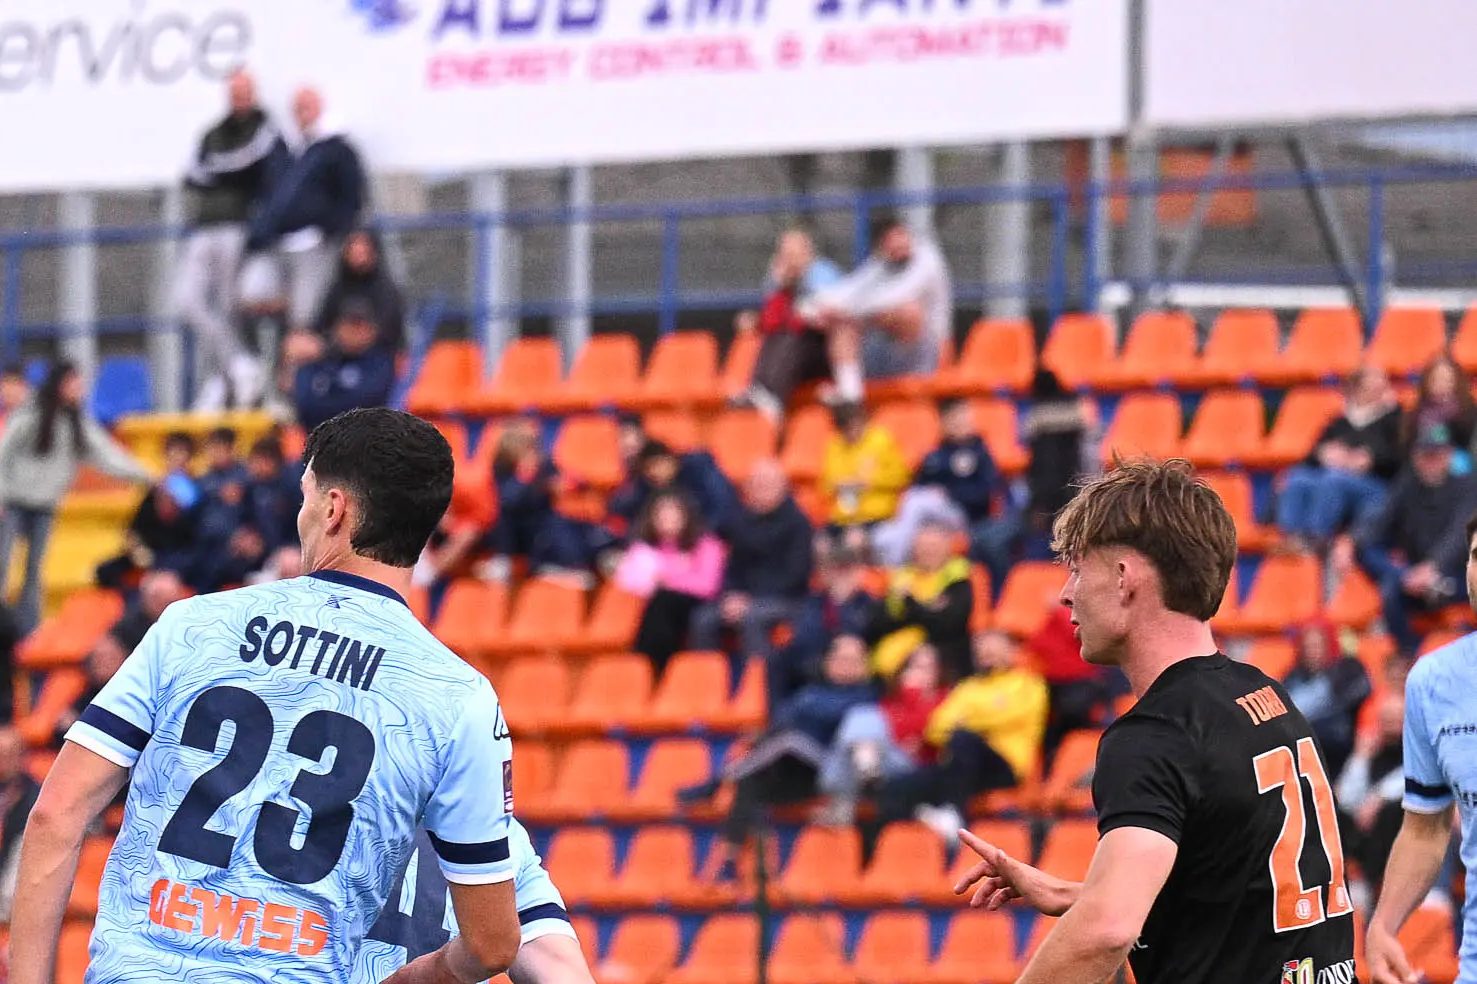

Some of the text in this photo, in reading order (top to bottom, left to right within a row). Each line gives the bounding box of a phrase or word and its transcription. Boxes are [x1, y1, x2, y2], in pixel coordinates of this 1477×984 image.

[424, 47, 572, 91] ENERGY
[585, 35, 764, 82] CONTROL
[820, 18, 1070, 66] AUTOMATION
[239, 615, 387, 691] SOTTINI
[157, 686, 376, 885] 23
[1253, 737, 1355, 933] 21
